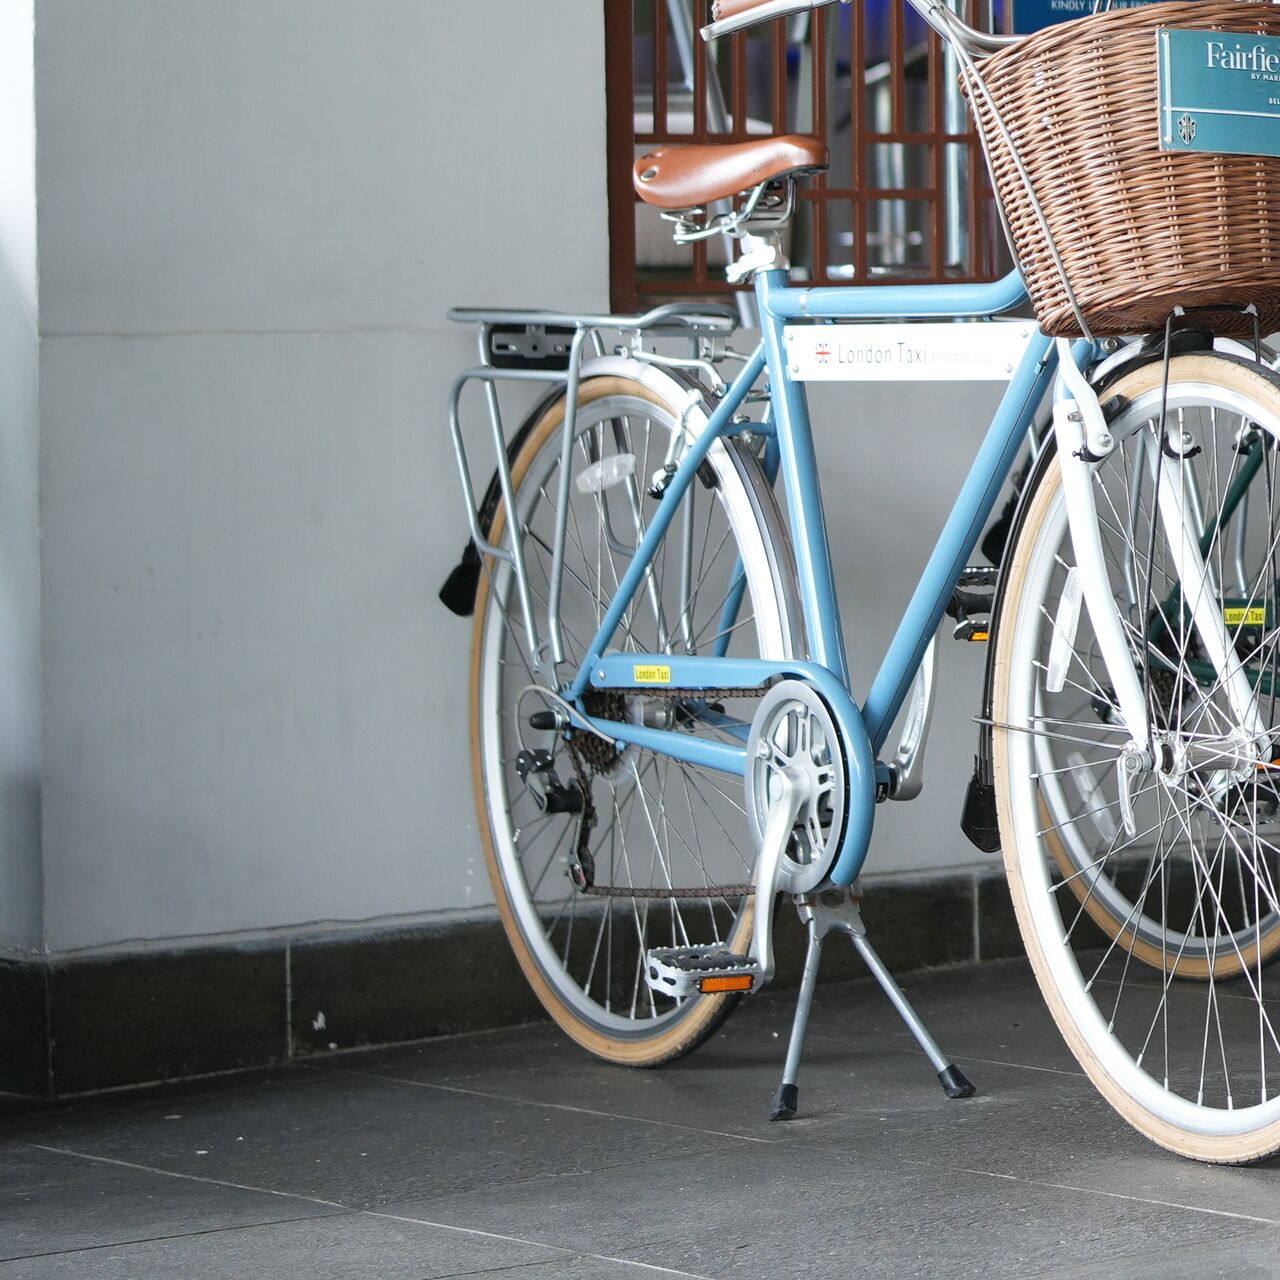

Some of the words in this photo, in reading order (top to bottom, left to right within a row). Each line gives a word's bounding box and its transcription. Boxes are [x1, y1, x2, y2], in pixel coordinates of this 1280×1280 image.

[1051, 0, 1086, 11] KINDLY
[1251, 73, 1261, 81] BY
[838, 343, 893, 364] London
[897, 342, 927, 364] Taxi
